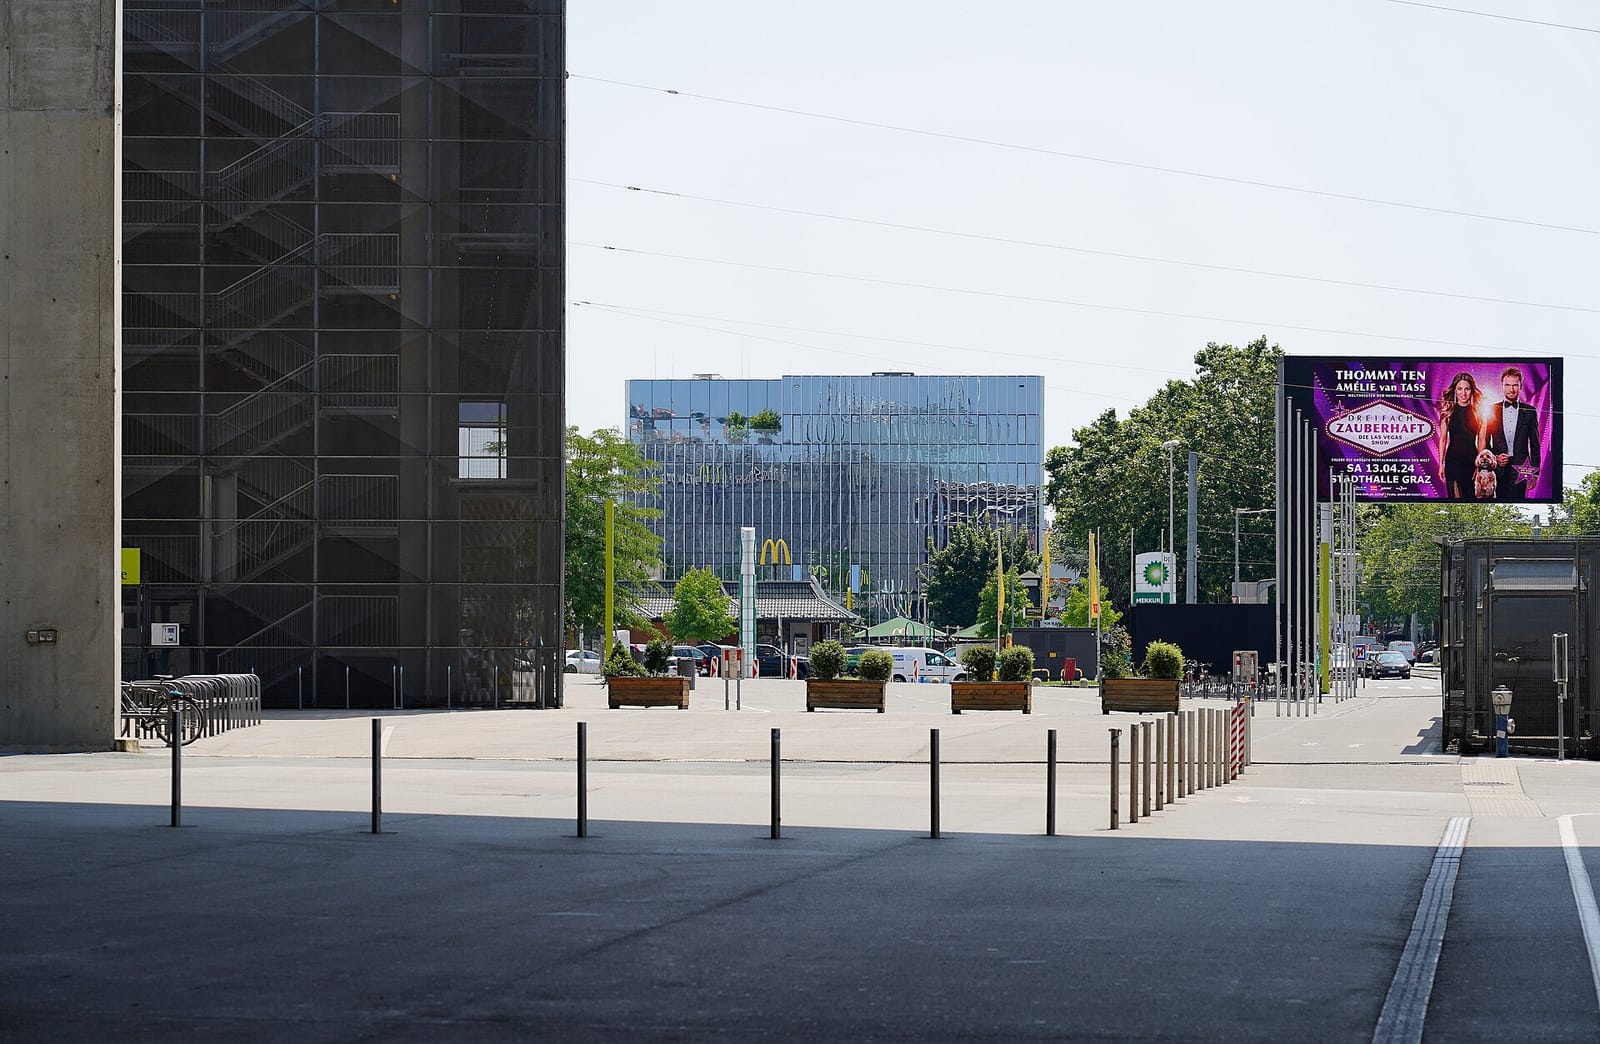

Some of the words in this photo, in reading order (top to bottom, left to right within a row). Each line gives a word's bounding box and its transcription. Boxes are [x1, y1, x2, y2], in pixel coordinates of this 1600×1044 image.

[1335, 370, 1397, 380] THOMMY
[1400, 370, 1426, 380] TEN
[1335, 381, 1377, 392] AMÉLIE
[1379, 384, 1397, 392] van
[1400, 383, 1426, 392] TASS
[1336, 423, 1425, 433] ZAUBERHAFT
[1346, 463, 1363, 473] SA
[1366, 463, 1415, 473] 13.04.24
[1402, 475, 1432, 484] GRAZ
